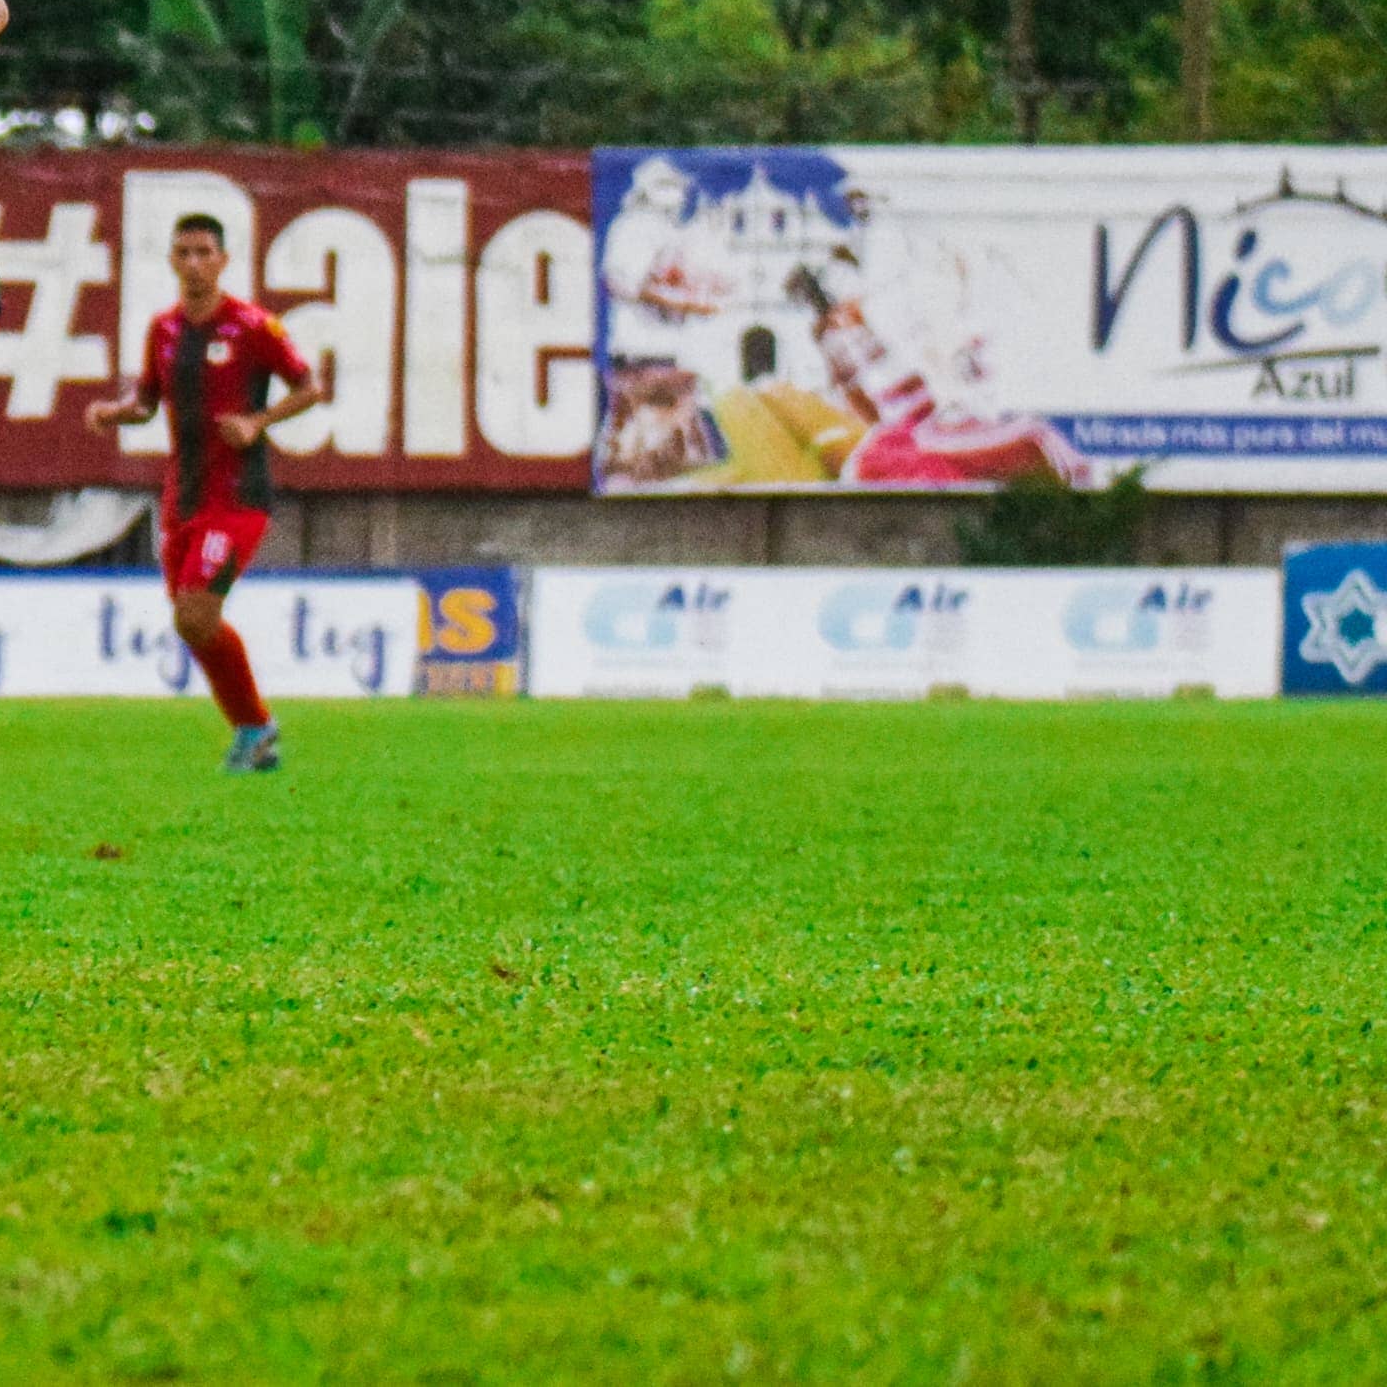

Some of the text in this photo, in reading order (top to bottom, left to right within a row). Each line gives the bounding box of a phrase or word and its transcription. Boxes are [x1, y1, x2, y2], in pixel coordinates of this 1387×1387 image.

[1252, 356, 1357, 400] Azul
[658, 580, 729, 610] Air
[893, 581, 969, 611] Air
[1139, 580, 1213, 611] Air
